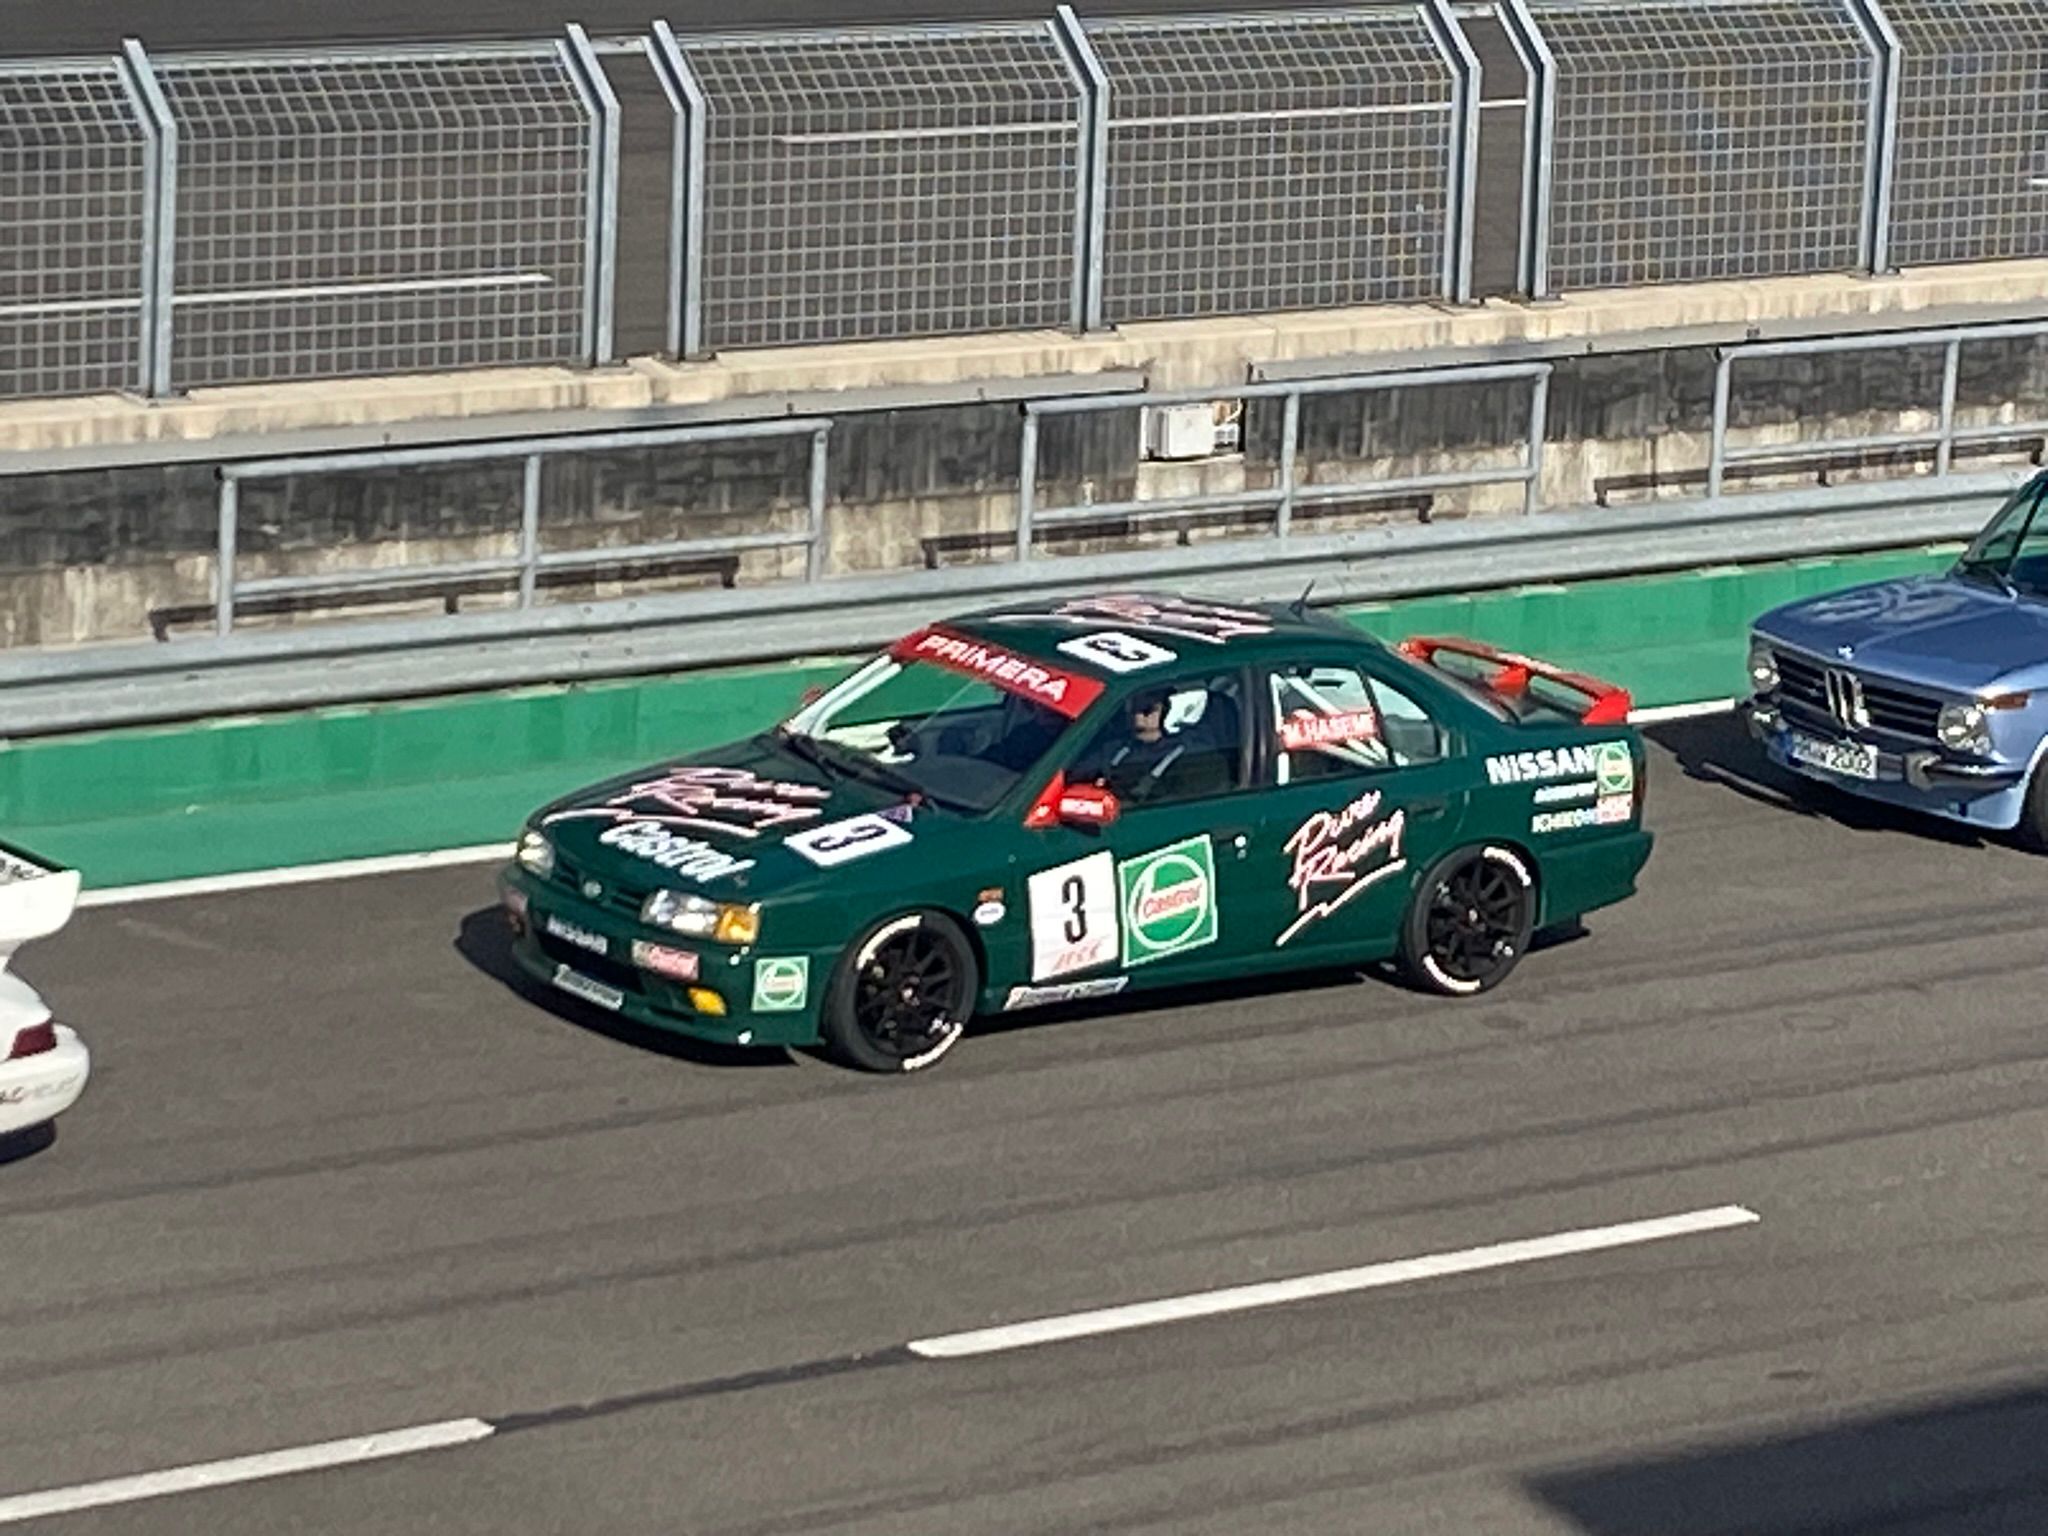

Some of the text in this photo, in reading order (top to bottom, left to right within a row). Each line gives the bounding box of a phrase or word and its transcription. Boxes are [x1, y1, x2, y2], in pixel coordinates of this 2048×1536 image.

[915, 633, 1070, 703] PRIMERA
[1485, 746, 1598, 785] NISSAN
[600, 820, 757, 883] Castrol
[808, 823, 890, 854] 3
[1061, 874, 1088, 945] 3
